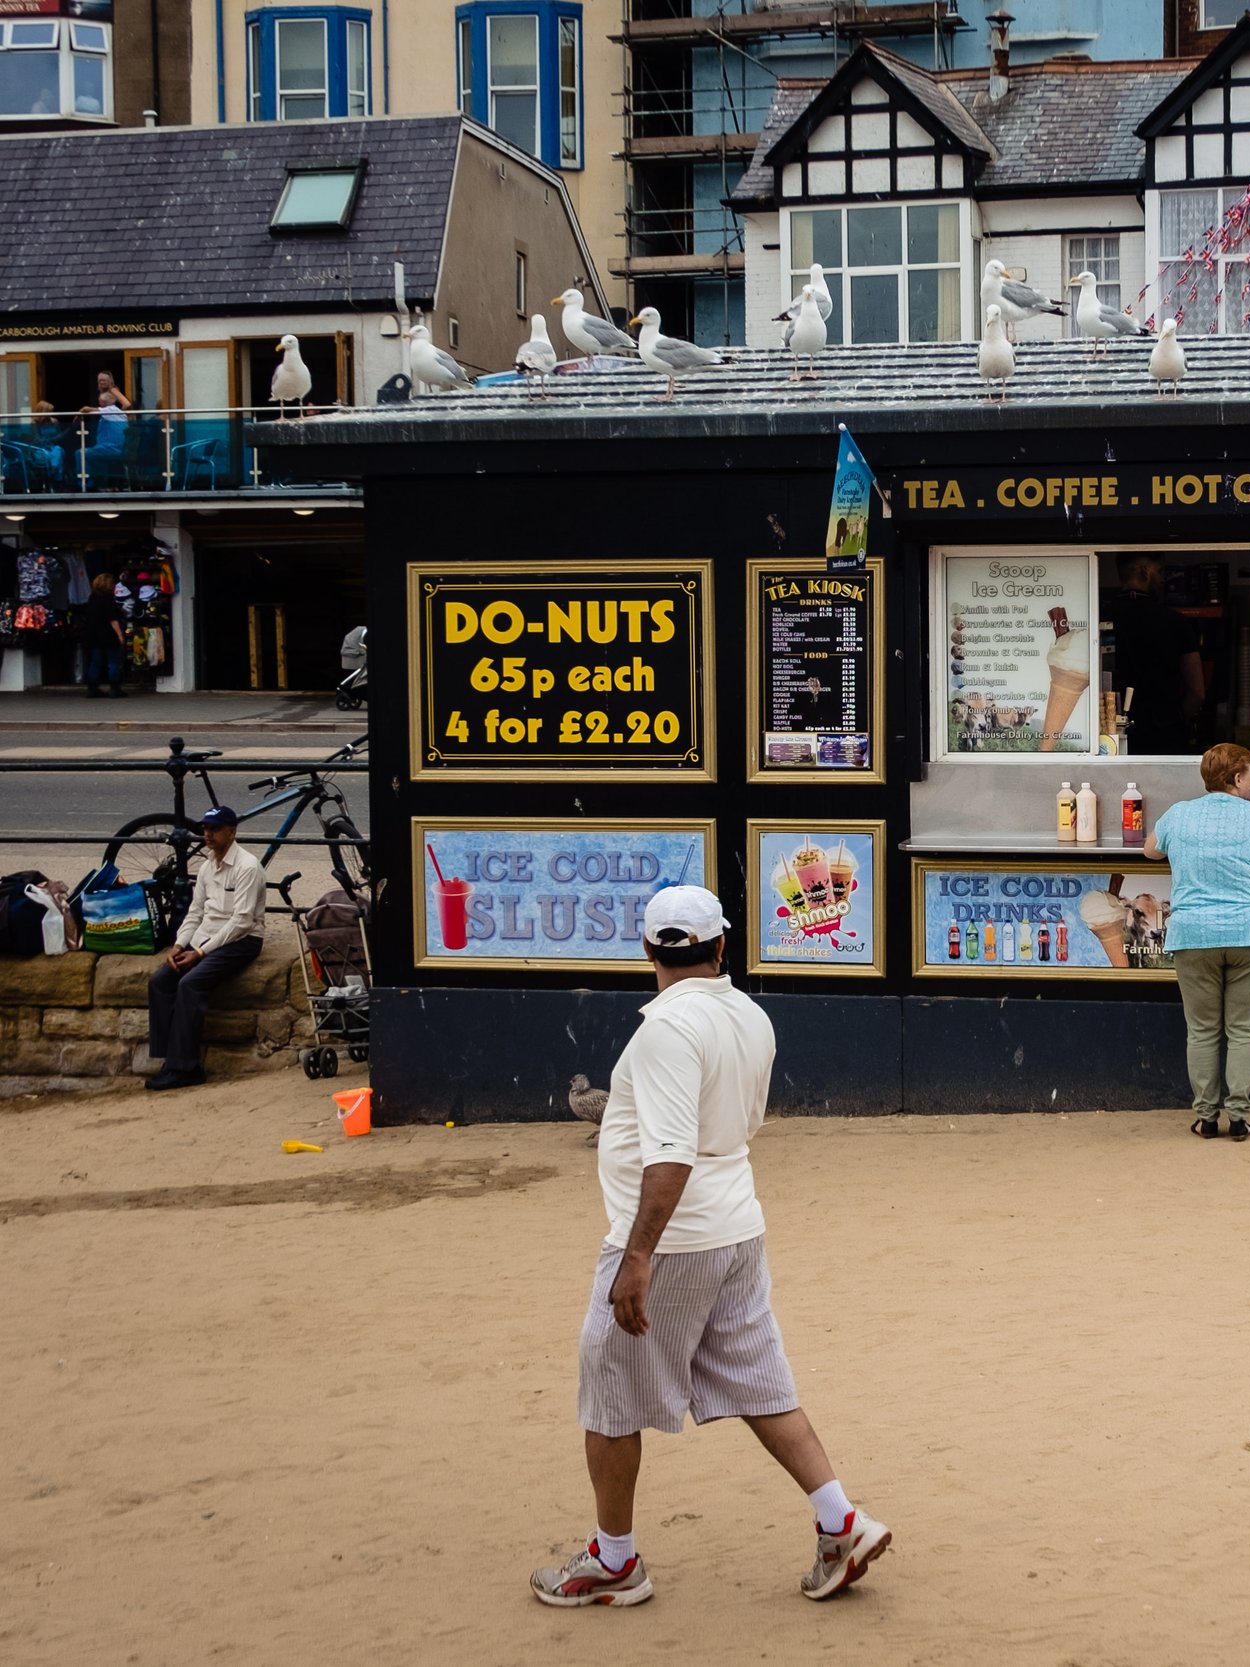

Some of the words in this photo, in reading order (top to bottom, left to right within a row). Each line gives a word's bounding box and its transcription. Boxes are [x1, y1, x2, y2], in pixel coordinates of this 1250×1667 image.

[62, 325, 105, 335] AMATEUR
[107, 323, 146, 333] ROWING
[148, 322, 173, 332] CLUB
[904, 480, 965, 508] TEA
[997, 477, 1119, 506] COFFEE
[1152, 474, 1224, 503] HOT
[989, 561, 1046, 582] Scoop
[765, 582, 801, 600] TEA
[808, 580, 865, 601] KIOSK
[972, 581, 998, 597] Ice
[1002, 581, 1063, 597] Cream
[961, 605, 989, 614] Vanilla
[991, 605, 1010, 614] with
[1012, 605, 1028, 614] Pod
[445, 600, 675, 644] DO-NUTS
[961, 619, 1012, 628] Strawberries
[1027, 618, 1057, 628] Clotted
[1060, 619, 1087, 628] Cream
[961, 634, 990, 644] Belgian
[994, 634, 1034, 642] Chocolate
[961, 648, 999, 656] Brownies
[1012, 648, 1040, 656] Cream
[961, 663, 980, 672] Rum
[994, 663, 1018, 672] Raisin
[470, 657, 555, 698] 65p
[568, 657, 655, 692] each
[961, 678, 1007, 687] Bubblegum
[962, 692, 982, 700] Mint
[986, 692, 1026, 700] Chocolate
[1028, 692, 1047, 702] Chip
[962, 706, 1010, 716] Honeycomb
[1014, 706, 1034, 714] Swirl
[445, 711, 470, 743] 4
[484, 709, 543, 743] for
[559, 710, 680, 743] £2.20
[956, 731, 1006, 740] Farmhouse
[1008, 731, 1033, 741] Dairy
[1035, 731, 1050, 739] Ice
[1052, 731, 1082, 739] Cream
[465, 851, 534, 883] ICE
[549, 851, 660, 883] COLD
[939, 876, 990, 897] ICE
[1000, 876, 1082, 897] COLD
[787, 900, 851, 930] shmoo
[951, 902, 1062, 923] DRINKS
[781, 936, 802, 945] fresh
[797, 946, 832, 957] shakes
